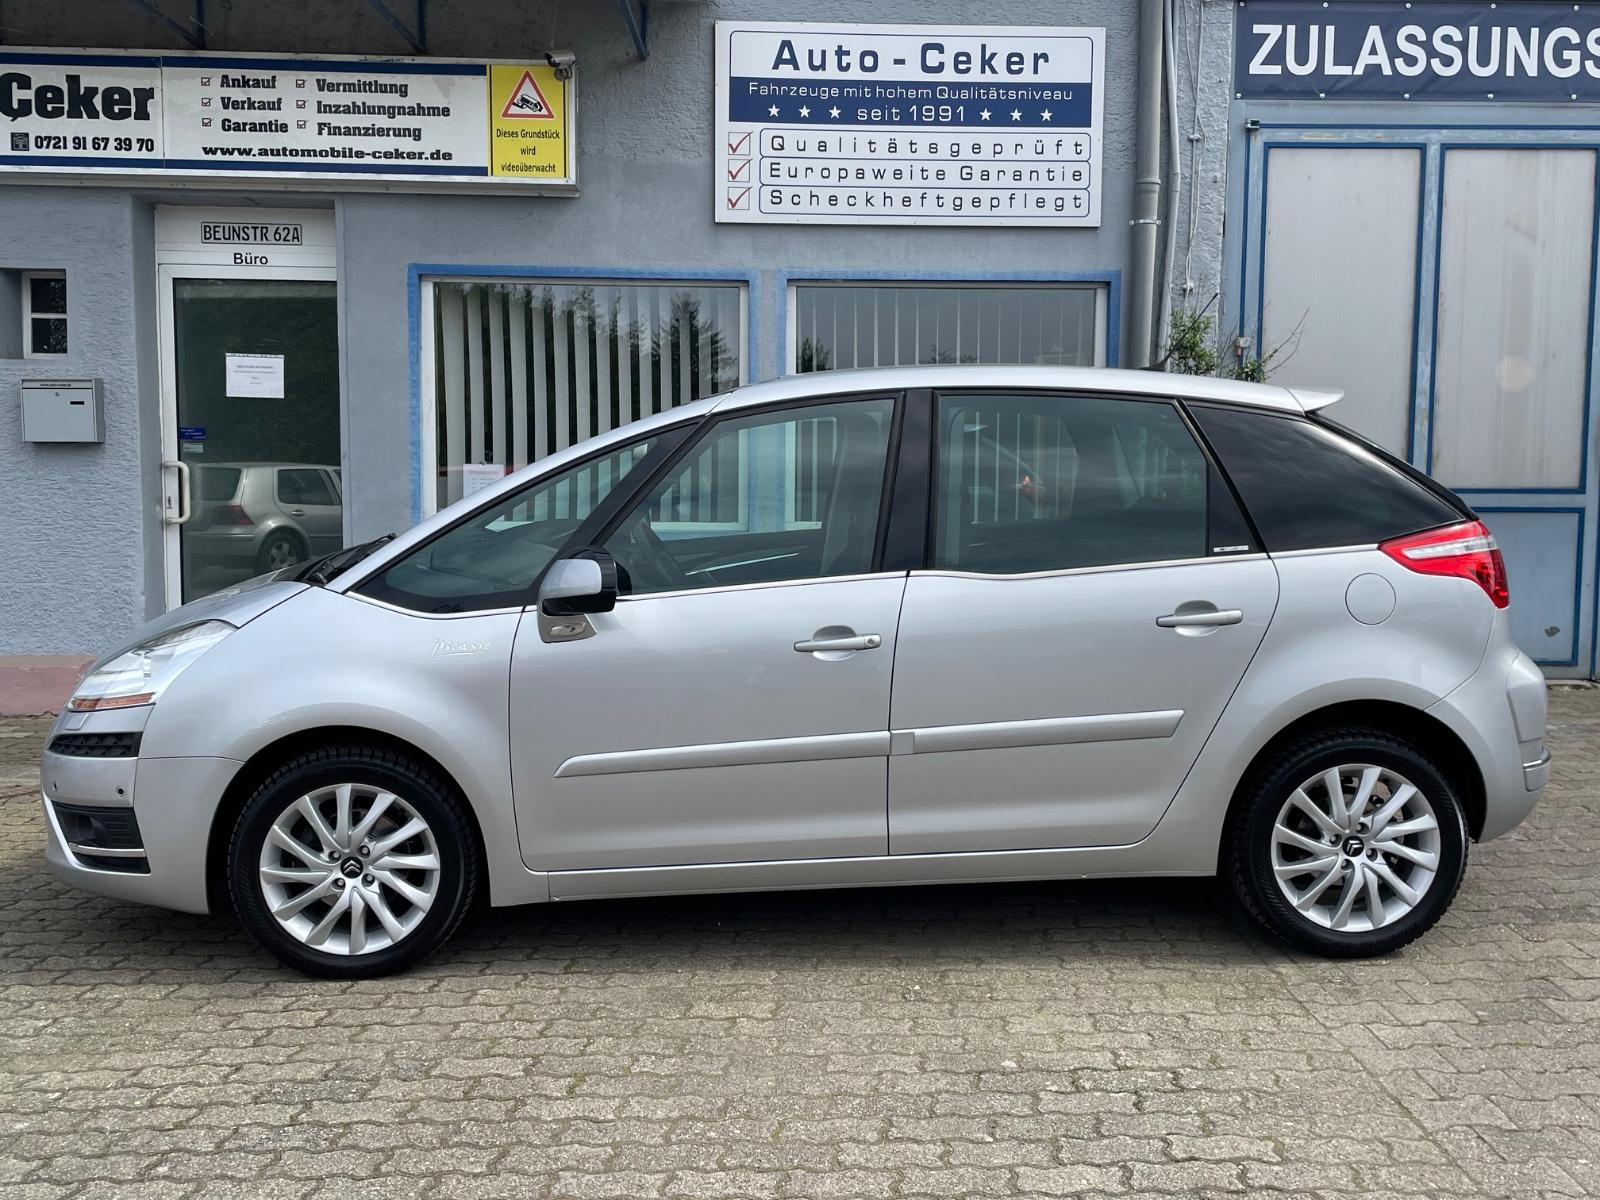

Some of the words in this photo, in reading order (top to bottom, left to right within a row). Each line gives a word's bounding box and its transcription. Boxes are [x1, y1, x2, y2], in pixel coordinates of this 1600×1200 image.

[772, 39, 879, 73] Auto
[920, 42, 1049, 76] Ceker
[220, 75, 277, 90] Ankauf
[316, 78, 409, 98] Vermittlung
[749, 82, 839, 99] Fahrzeuge
[844, 85, 871, 98] mit
[876, 85, 932, 99] hohem
[936, 86, 1073, 100] Qualitätsniveau
[220, 97, 282, 112] Verkauf
[316, 101, 450, 119] Inzahlungnahme
[857, 105, 900, 121] seit
[909, 105, 964, 122] 1991
[221, 118, 289, 133] Garantie
[317, 122, 422, 141] Finanzierung
[496, 128, 519, 138] Dieses
[520, 129, 560, 139] Grundstück
[34, 135, 67, 150] 0721
[72, 136, 87, 151] 91
[92, 137, 110, 151] 67
[114, 137, 132, 151] 39
[136, 138, 155, 152] 70
[520, 146, 536, 155] wird
[771, 135, 1083, 158] Qualitätsgeprüft
[202, 147, 453, 161] www.automobile-ceker.de
[501, 162, 556, 173] videoüberwacht
[769, 162, 946, 183] Europaweite
[960, 165, 1082, 182] Garantie
[770, 189, 1082, 212] Scheckheftgepflegt
[273, 227, 300, 242] 62A
[233, 252, 269, 265] Büro
